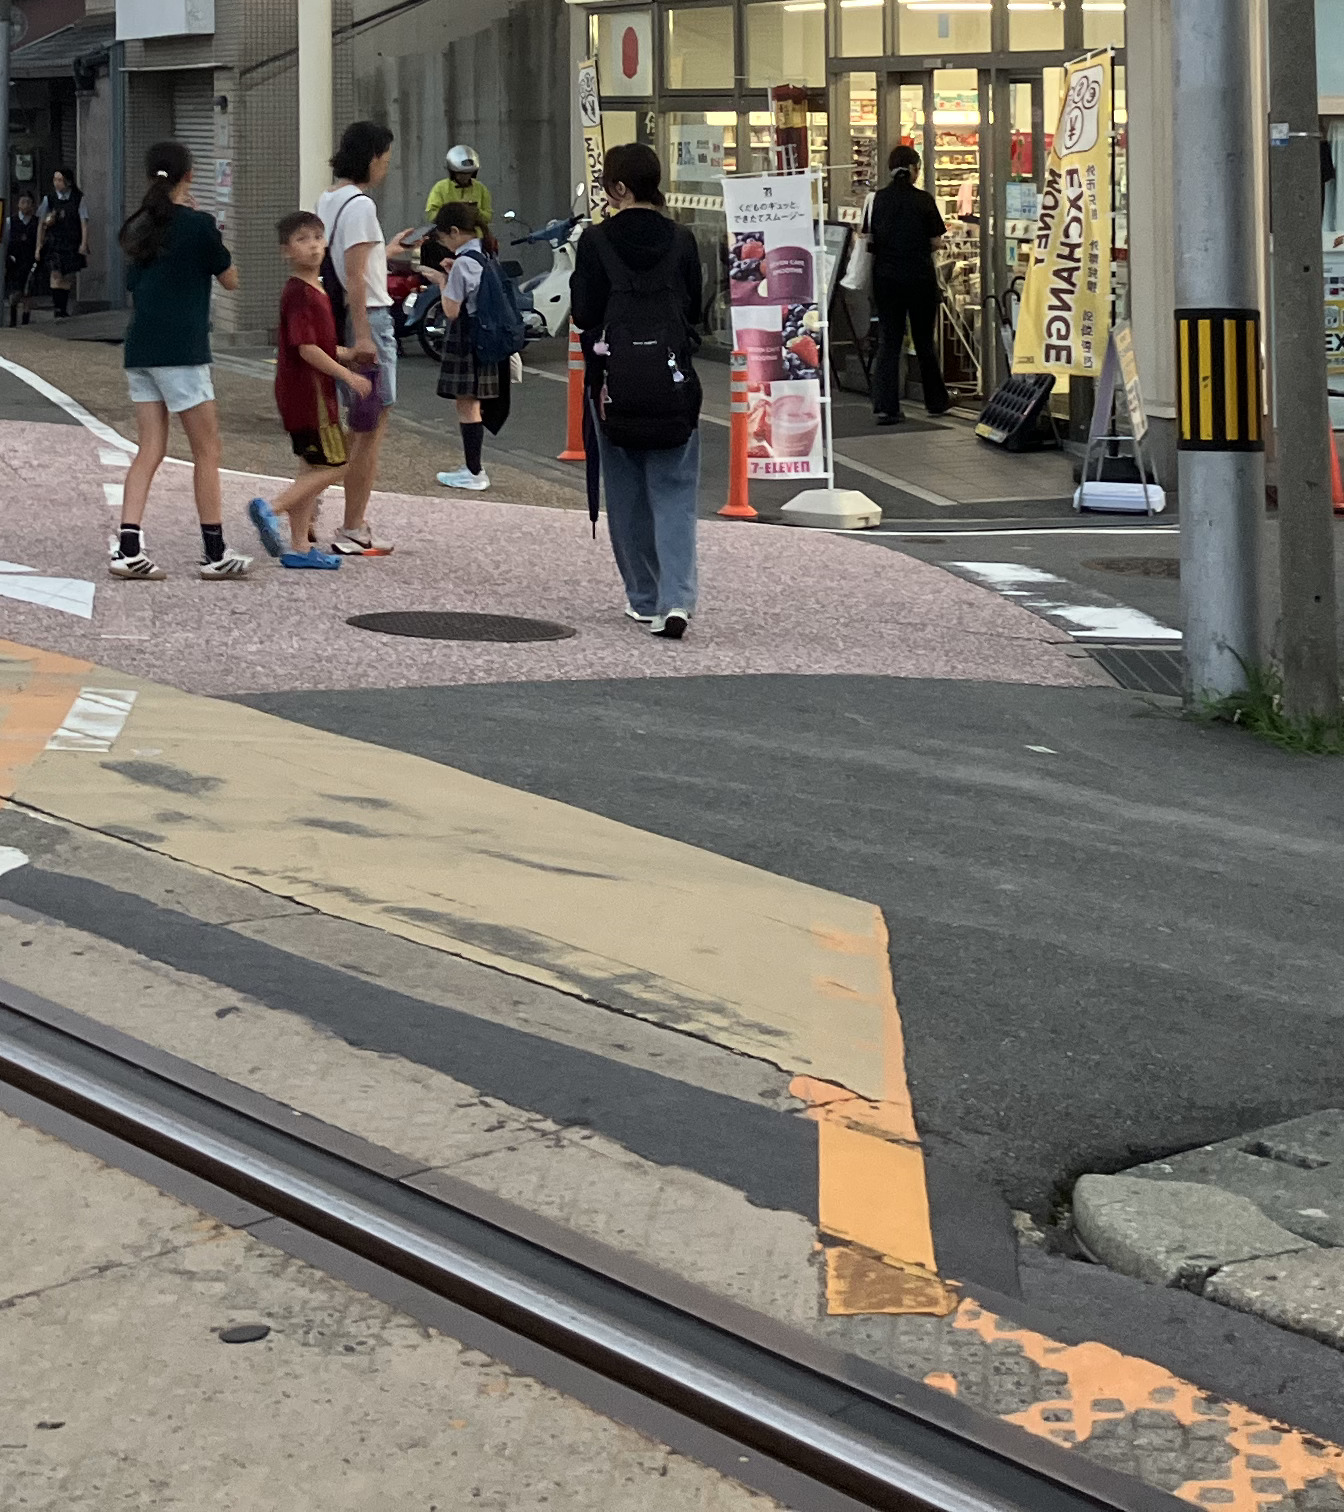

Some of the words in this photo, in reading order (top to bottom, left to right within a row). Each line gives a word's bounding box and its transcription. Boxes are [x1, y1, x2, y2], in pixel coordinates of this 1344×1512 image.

[734, 212, 805, 223] できたてスムージー
